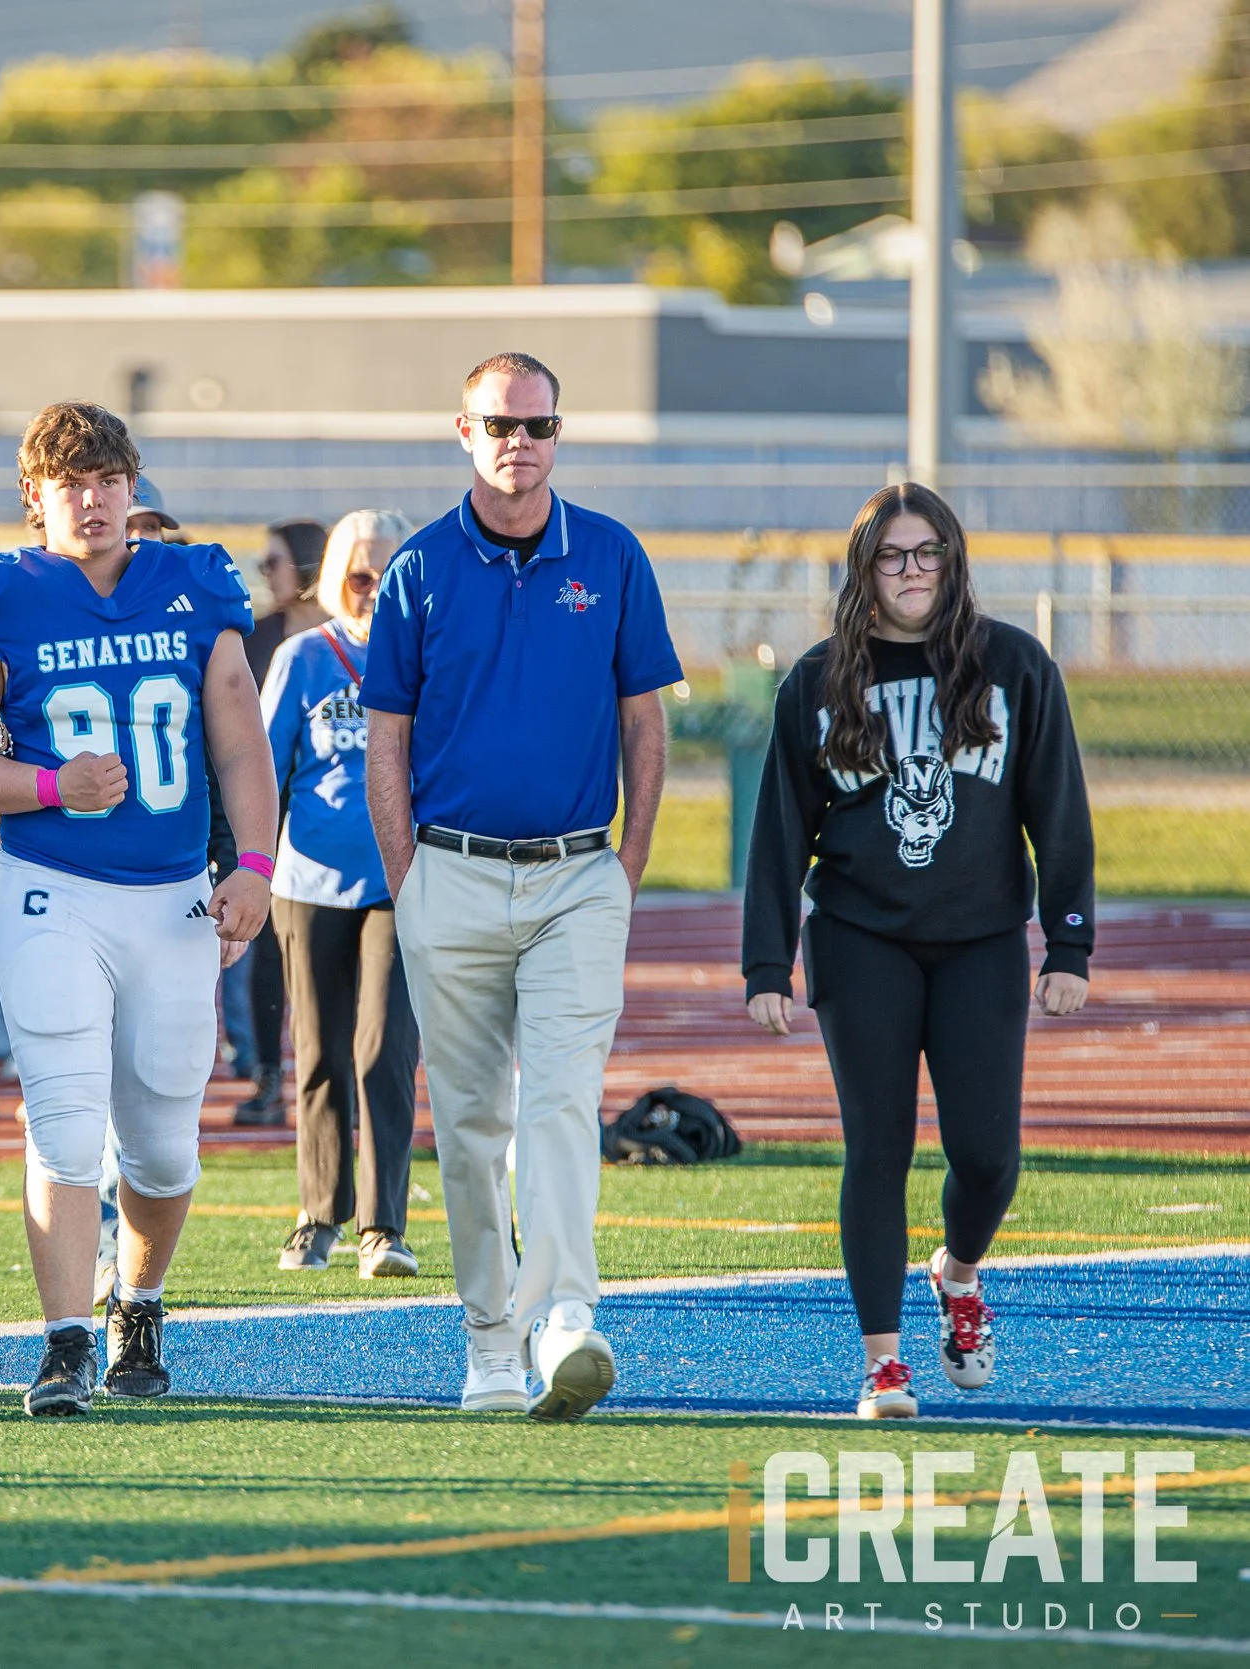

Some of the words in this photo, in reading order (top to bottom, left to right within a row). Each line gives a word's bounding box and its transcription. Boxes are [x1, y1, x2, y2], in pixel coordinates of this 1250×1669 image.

[555, 587, 601, 605] Tulsa
[36, 630, 188, 674] SENATORS
[321, 701, 365, 720] SEN
[42, 673, 192, 819] 90
[816, 676, 1010, 793] VAA
[903, 763, 937, 792] N
[23, 889, 49, 916] C
